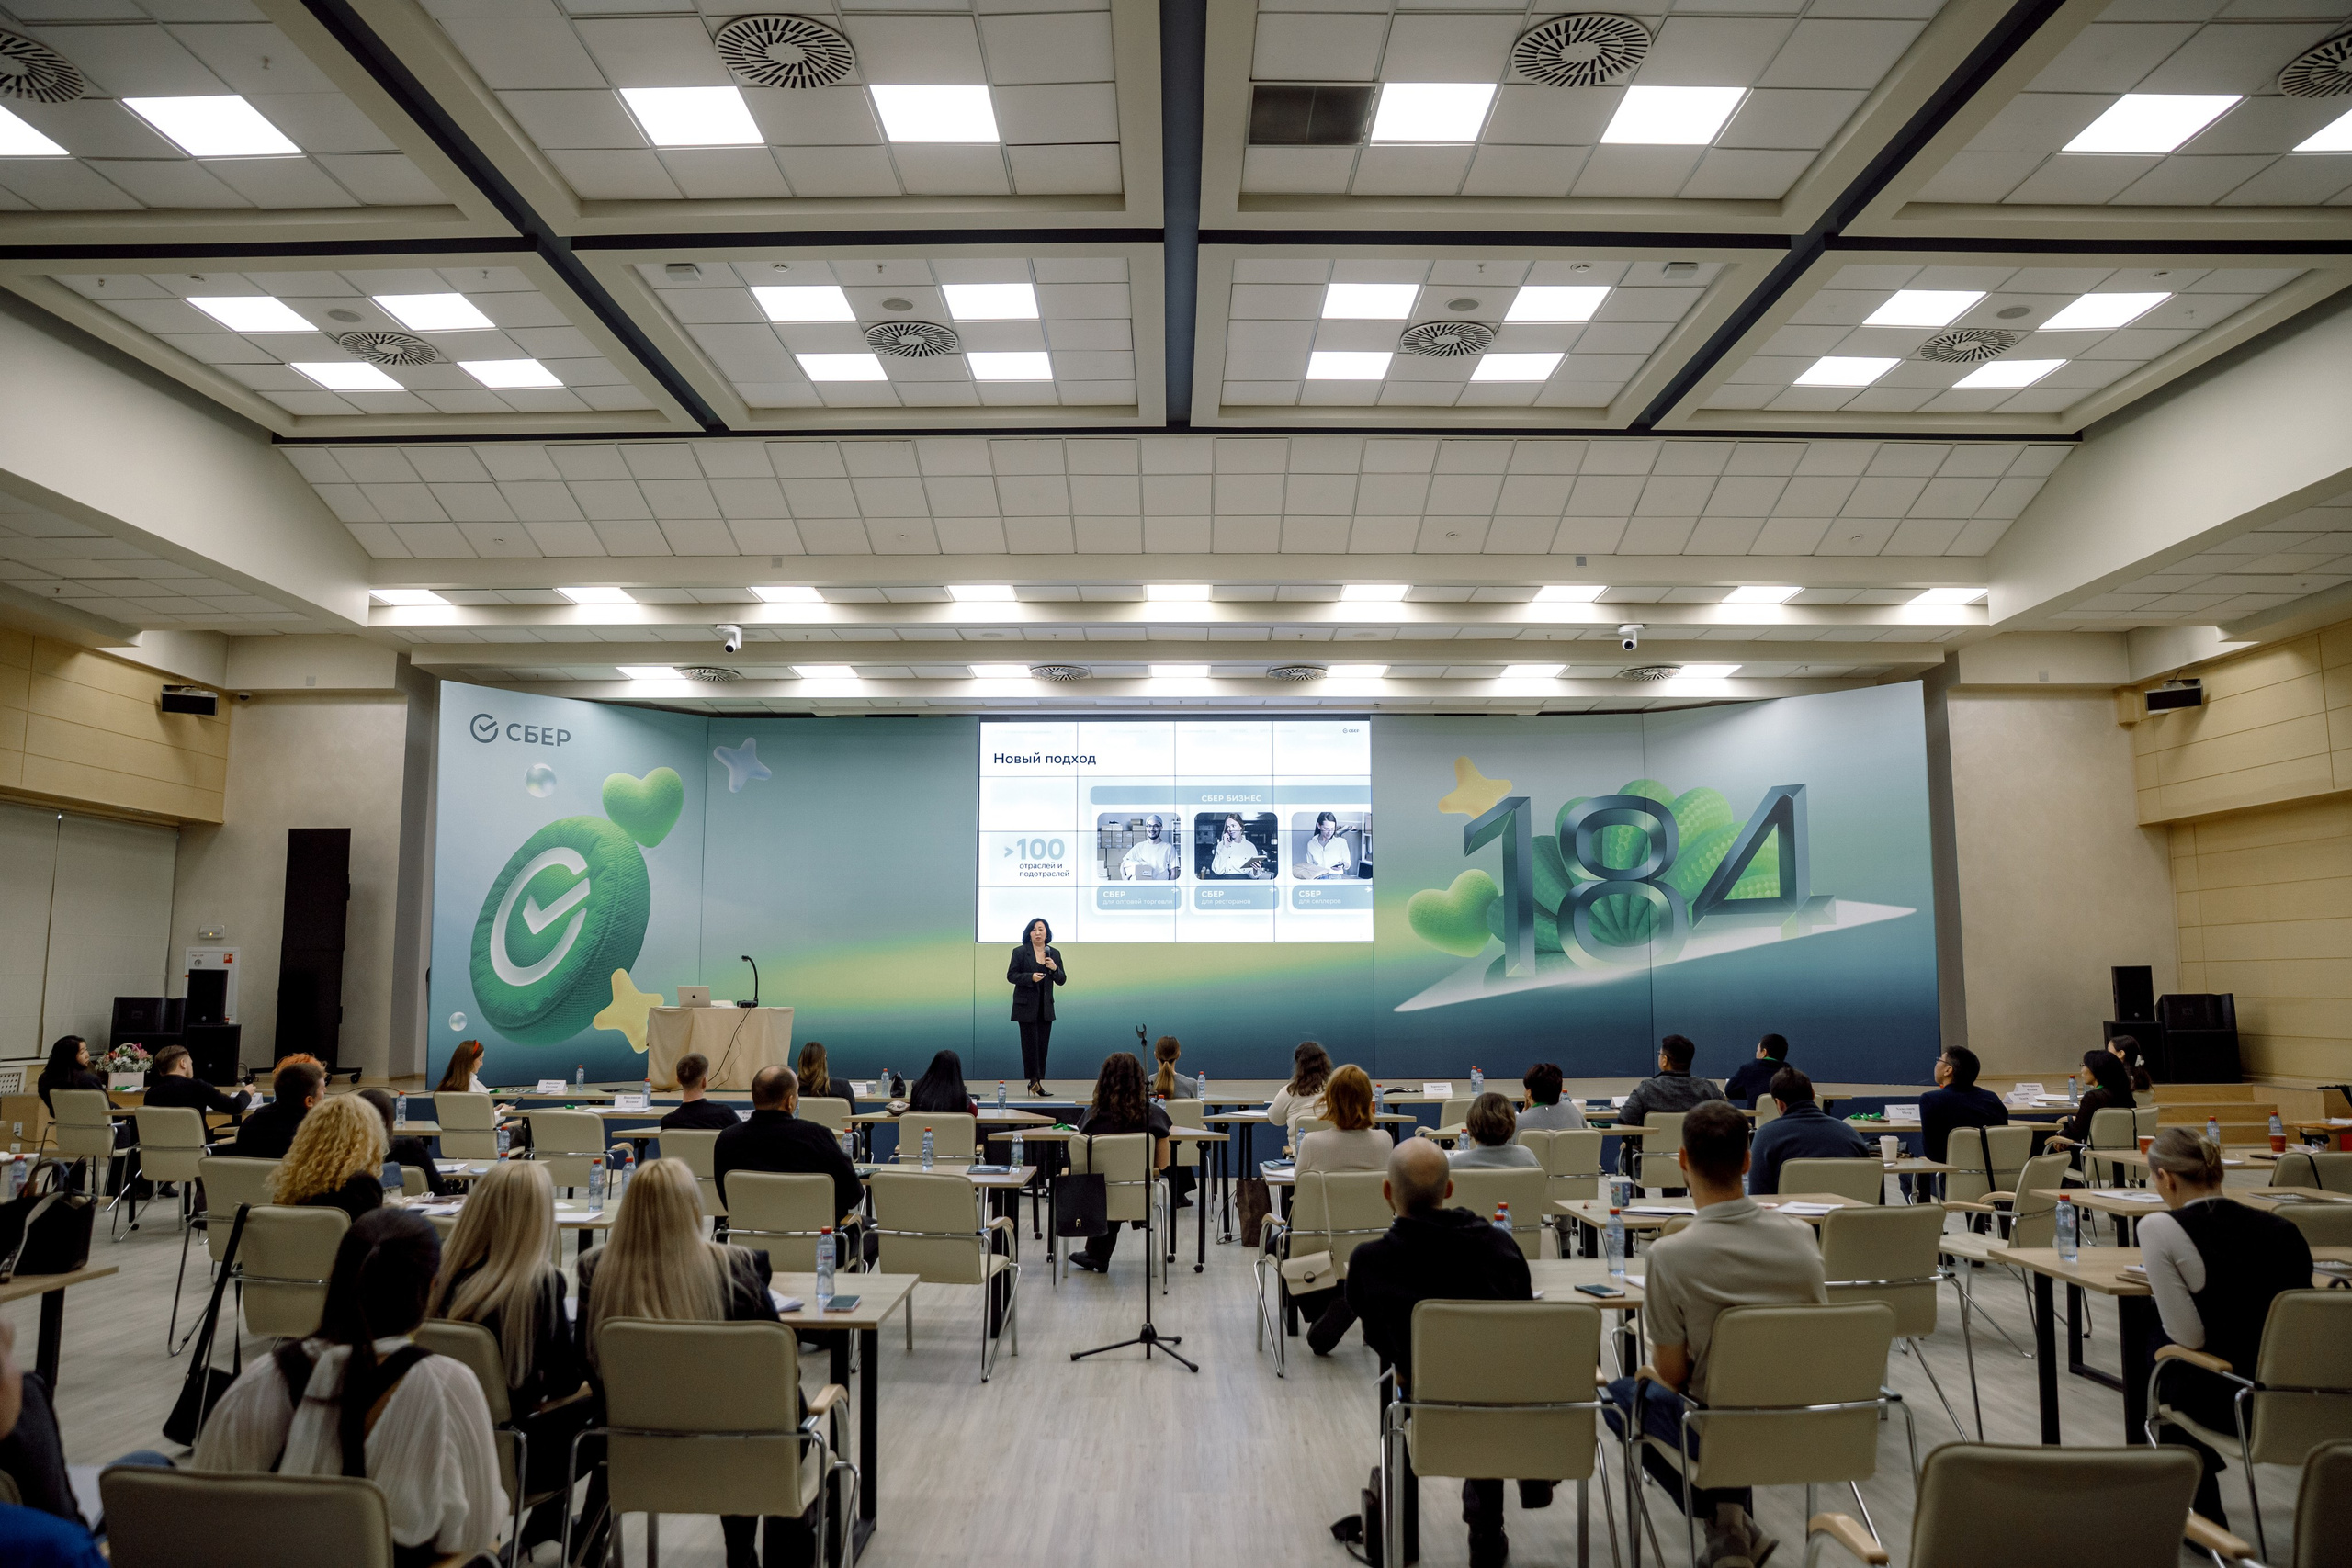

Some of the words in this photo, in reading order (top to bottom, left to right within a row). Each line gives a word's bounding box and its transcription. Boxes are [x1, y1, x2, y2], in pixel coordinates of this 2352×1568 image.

[506, 723, 571, 747] СБЕР
[994, 752, 1041, 764] Новый
[1046, 755, 1097, 766] подход
[1019, 862, 1056, 870] отраслей
[1019, 870, 1070, 878] подотраслей
[1464, 784, 1836, 977] 184
[1102, 890, 1126, 898] СБЕР
